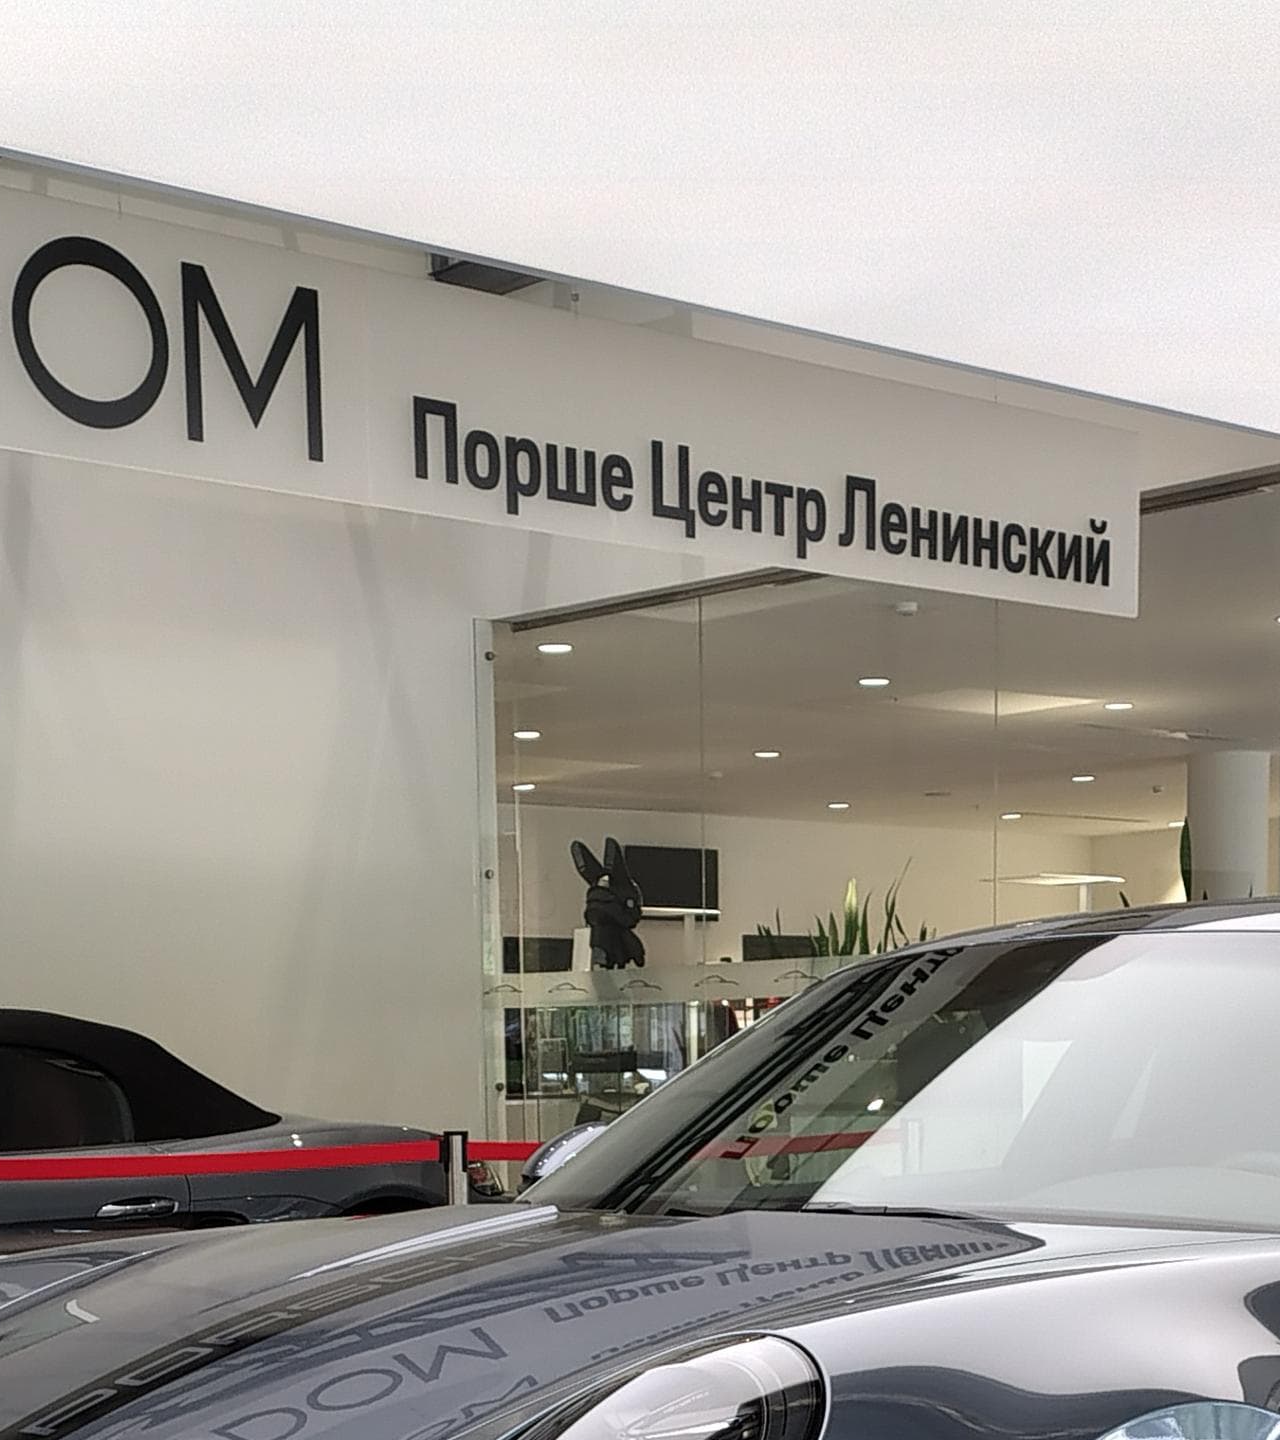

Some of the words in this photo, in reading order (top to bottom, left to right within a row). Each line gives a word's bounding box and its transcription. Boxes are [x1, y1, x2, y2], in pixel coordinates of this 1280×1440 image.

[412, 395, 634, 515] Порше
[651, 440, 825, 559] Центр
[838, 475, 1111, 587] Ленинский
